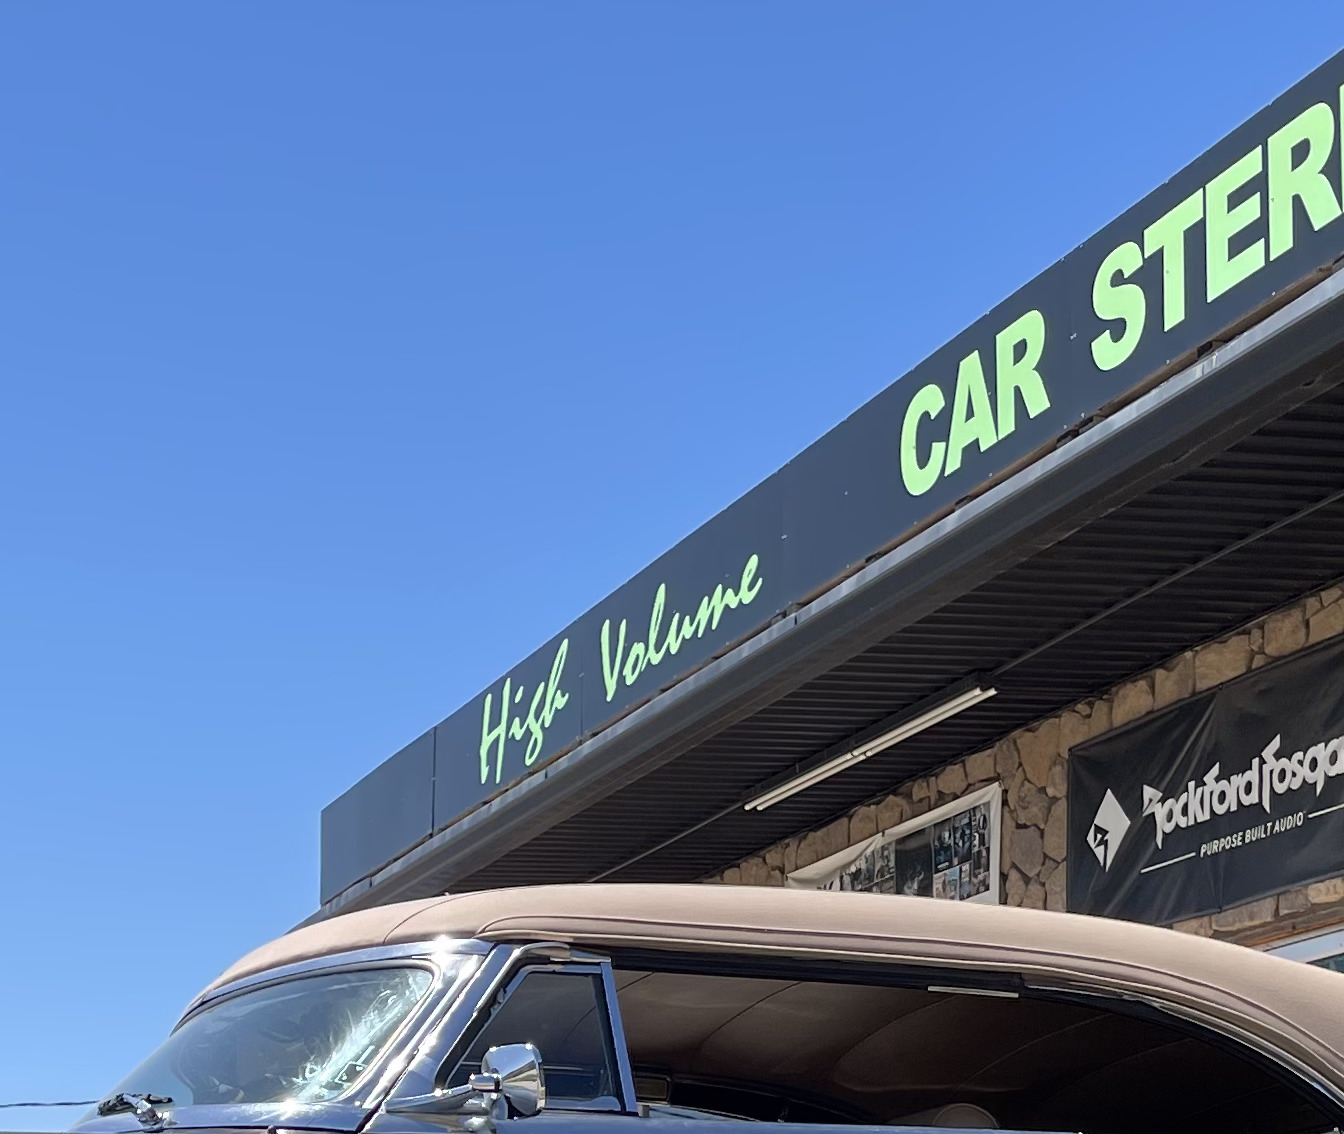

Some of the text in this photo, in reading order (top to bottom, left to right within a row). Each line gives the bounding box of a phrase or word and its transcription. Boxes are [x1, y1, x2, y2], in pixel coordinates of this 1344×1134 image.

[900, 309, 1051, 497] CAR
[479, 554, 763, 784] High Volume
[1142, 757, 1260, 850] Rockford
[1199, 811, 1305, 858] PURPOSE BUILT AUDIO
